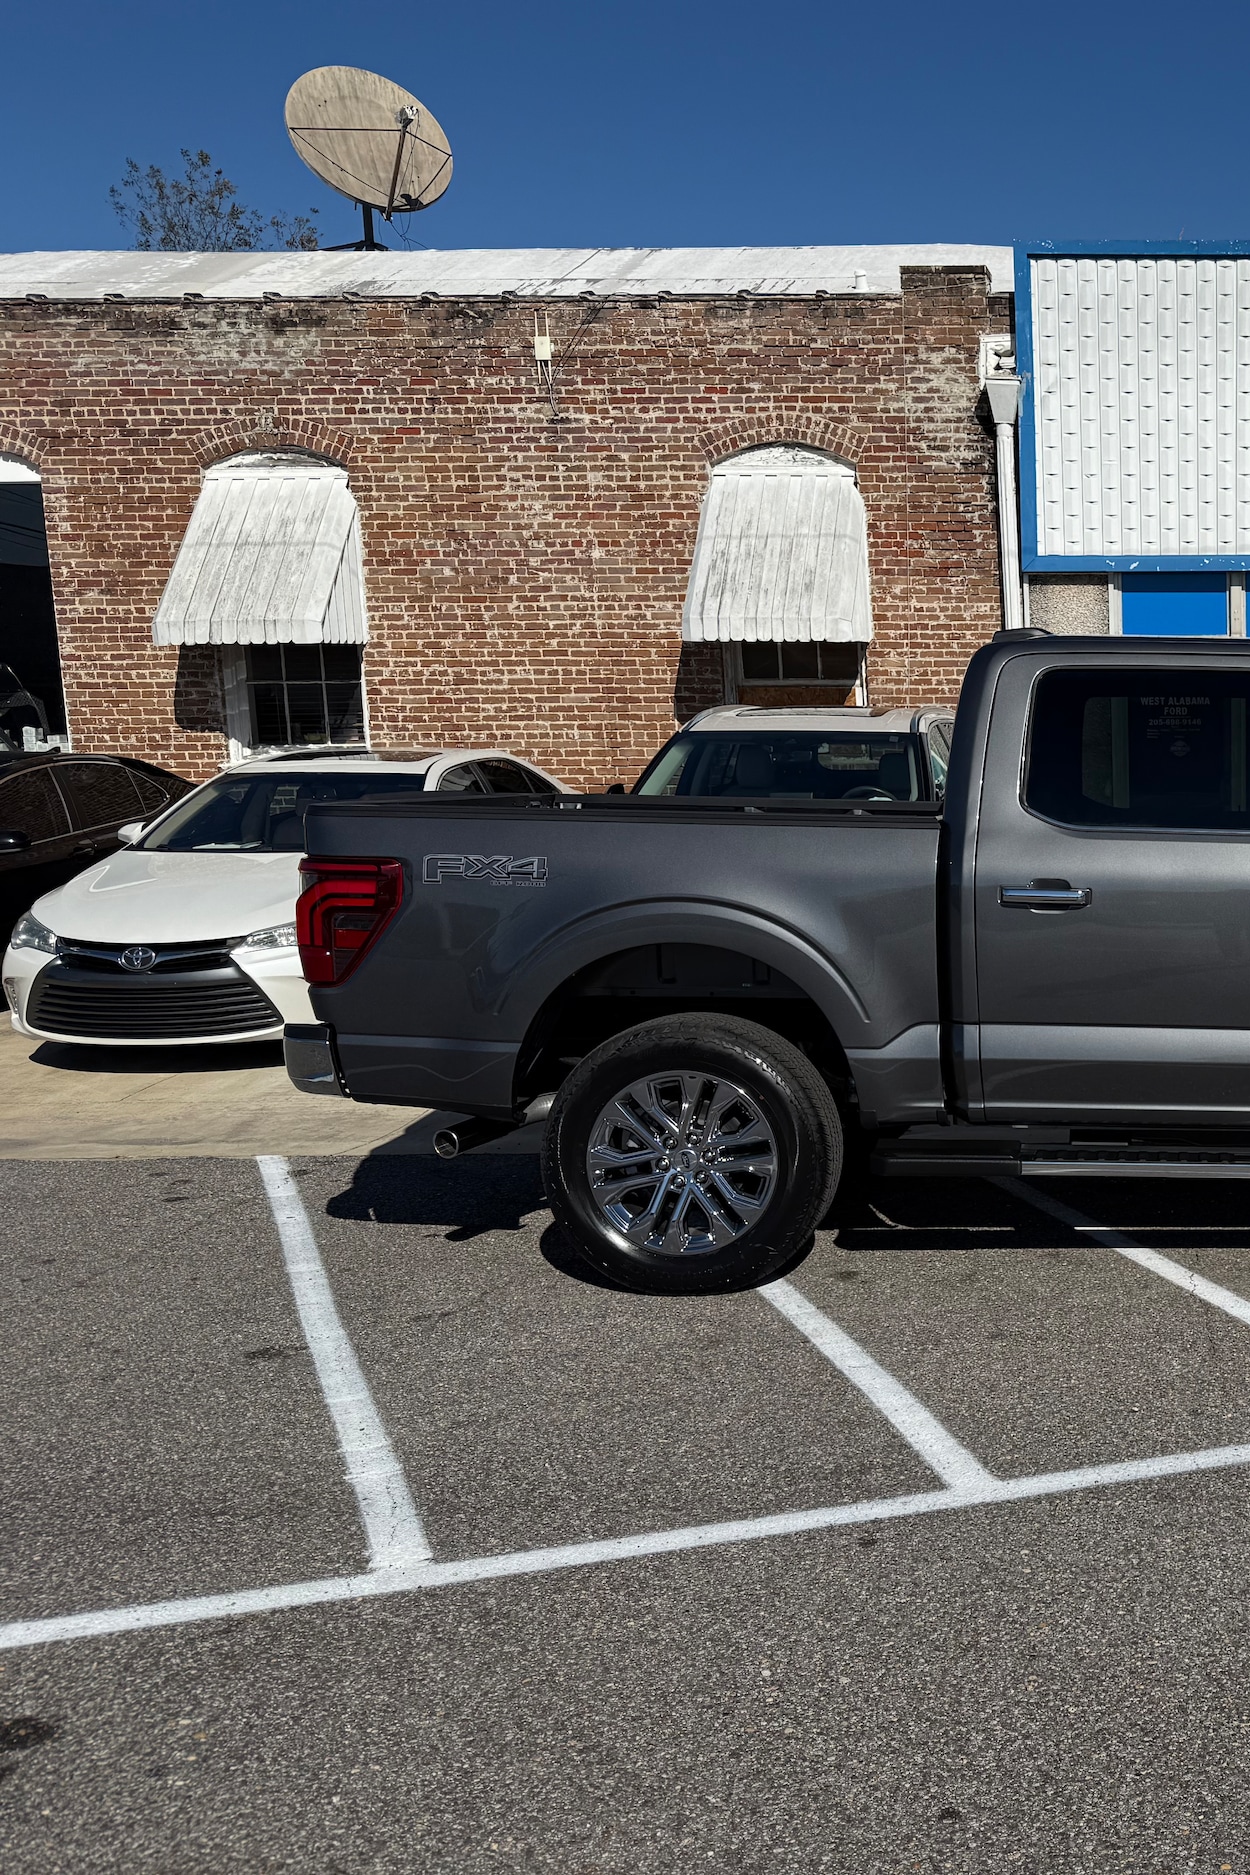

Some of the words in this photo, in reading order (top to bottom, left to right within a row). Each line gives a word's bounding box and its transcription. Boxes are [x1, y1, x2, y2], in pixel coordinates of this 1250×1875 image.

[1140, 697, 1165, 706] WEST
[1168, 696, 1210, 705] ALABAMA
[1164, 706, 1188, 716] FORD
[423, 853, 548, 884] FX4
